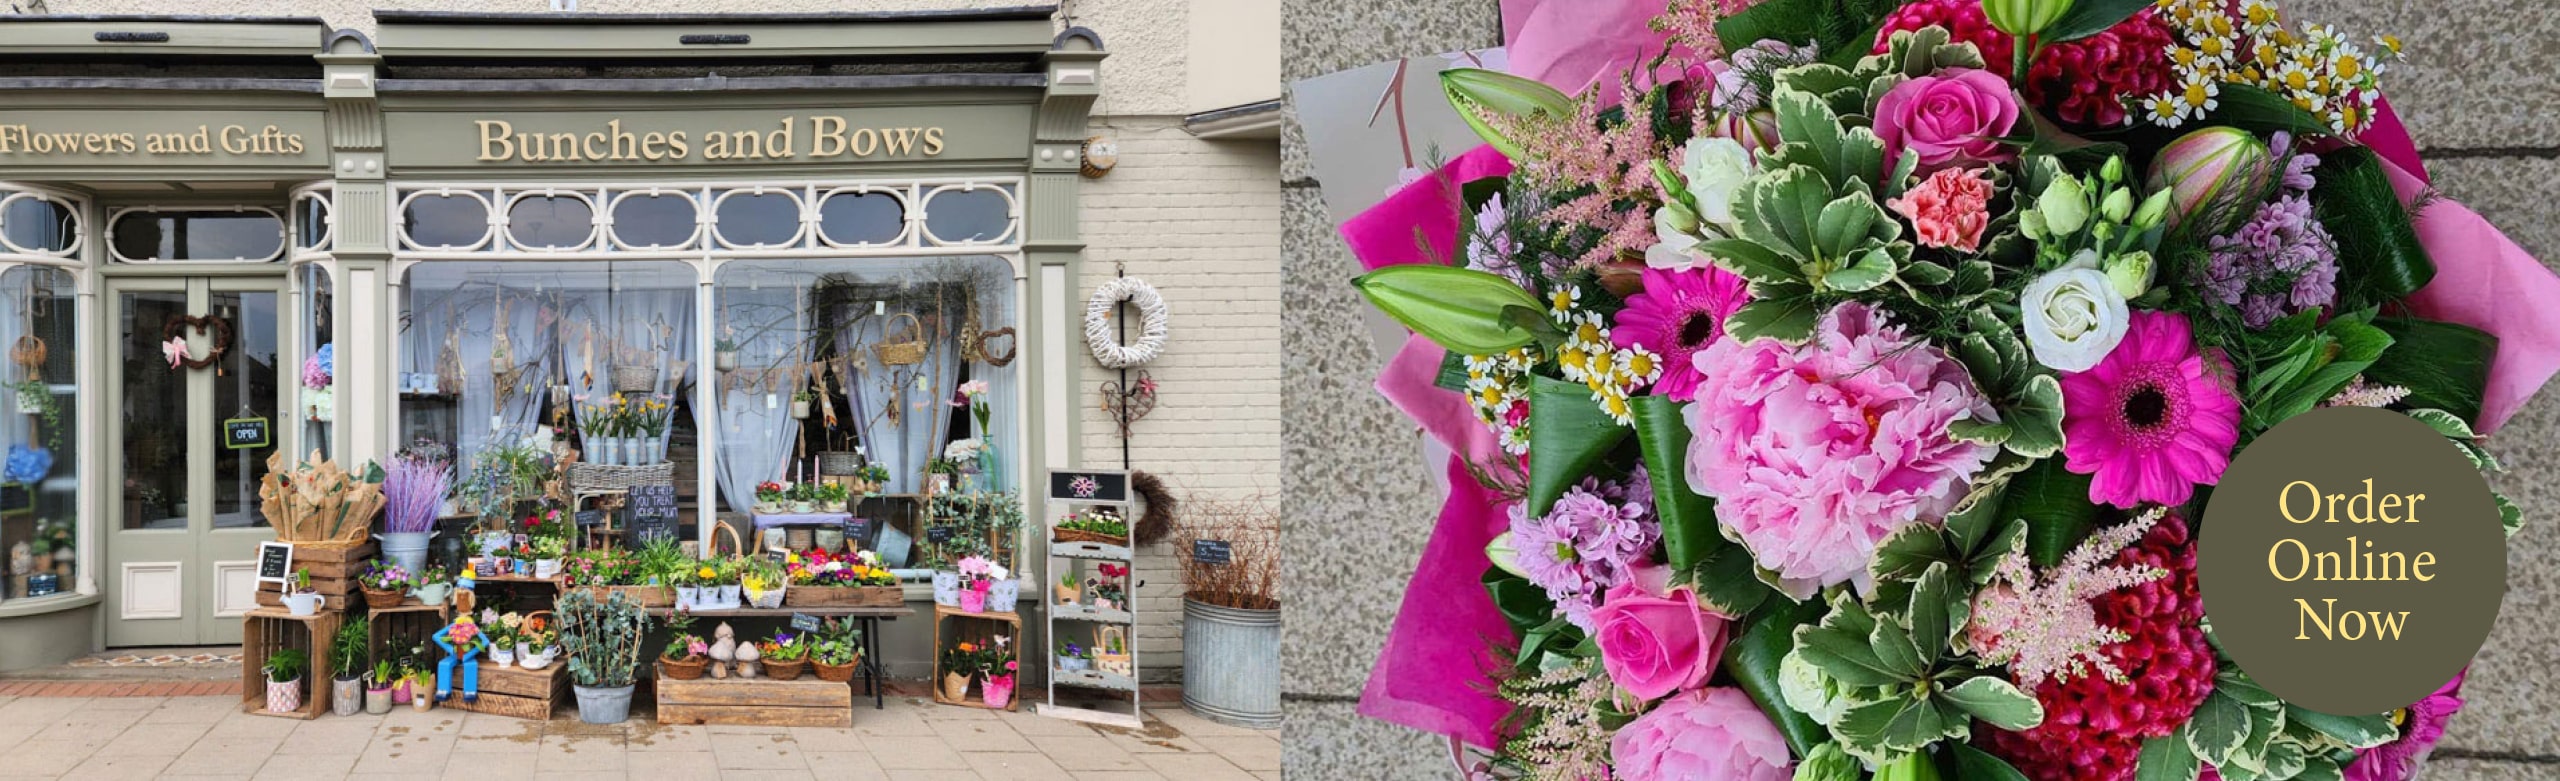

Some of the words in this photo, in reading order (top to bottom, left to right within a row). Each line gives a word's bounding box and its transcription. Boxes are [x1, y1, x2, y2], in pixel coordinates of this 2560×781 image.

[0, 124, 136, 154] Flowers
[145, 124, 212, 154] and
[220, 123, 304, 155] Gifts
[474, 118, 690, 162] Bunches
[703, 115, 796, 160] and
[807, 116, 945, 157] Bows
